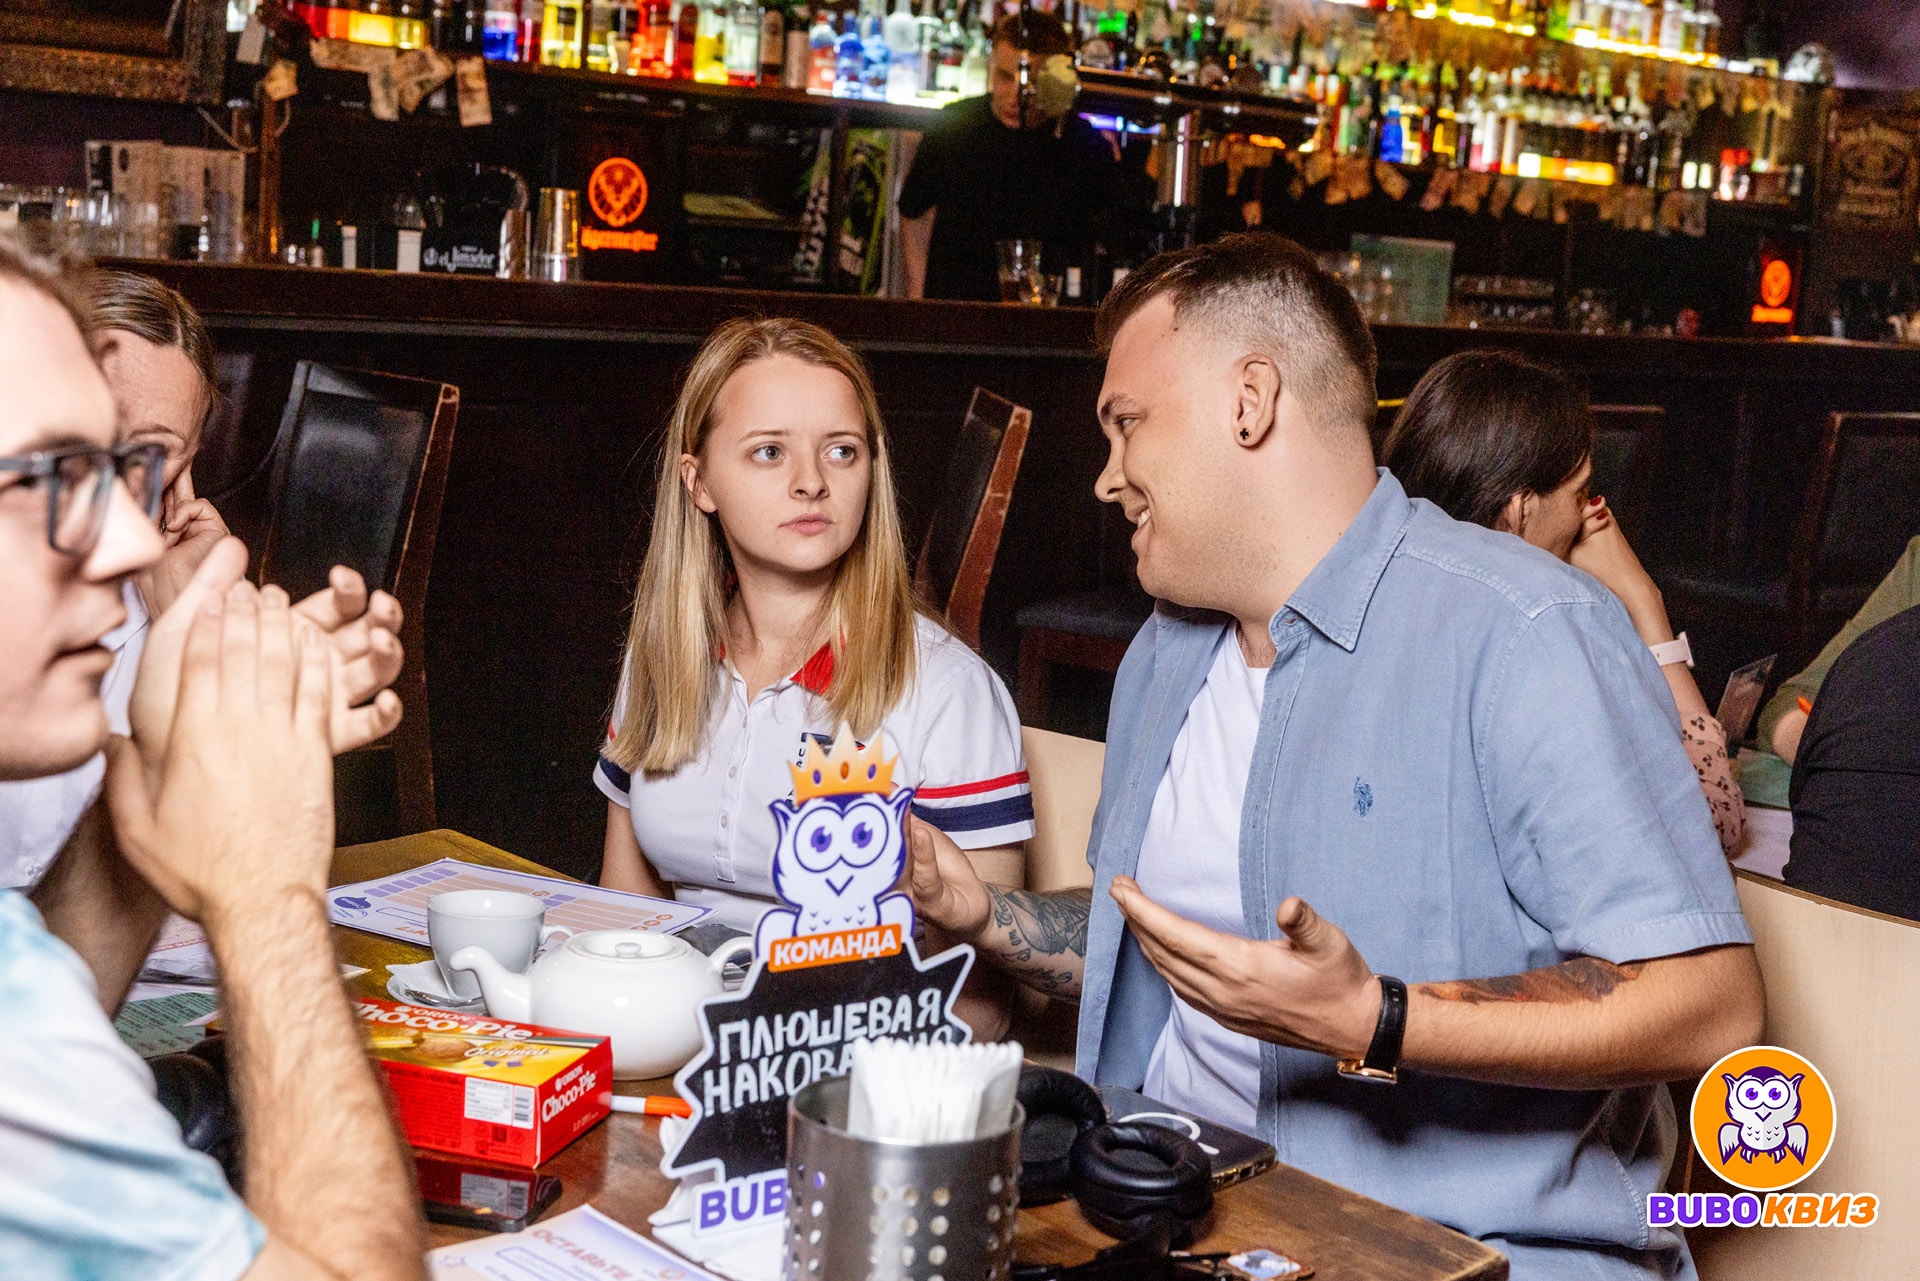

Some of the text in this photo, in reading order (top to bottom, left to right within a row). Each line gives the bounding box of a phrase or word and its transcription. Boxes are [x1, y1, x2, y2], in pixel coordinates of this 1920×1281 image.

[774, 929, 896, 966] КОМАНДА
[718, 988, 942, 1065] ПЛЮШЕВАЯ
[700, 1178, 787, 1230] BUB
[531, 1228, 633, 1280] ОСТАВЬТЕ
